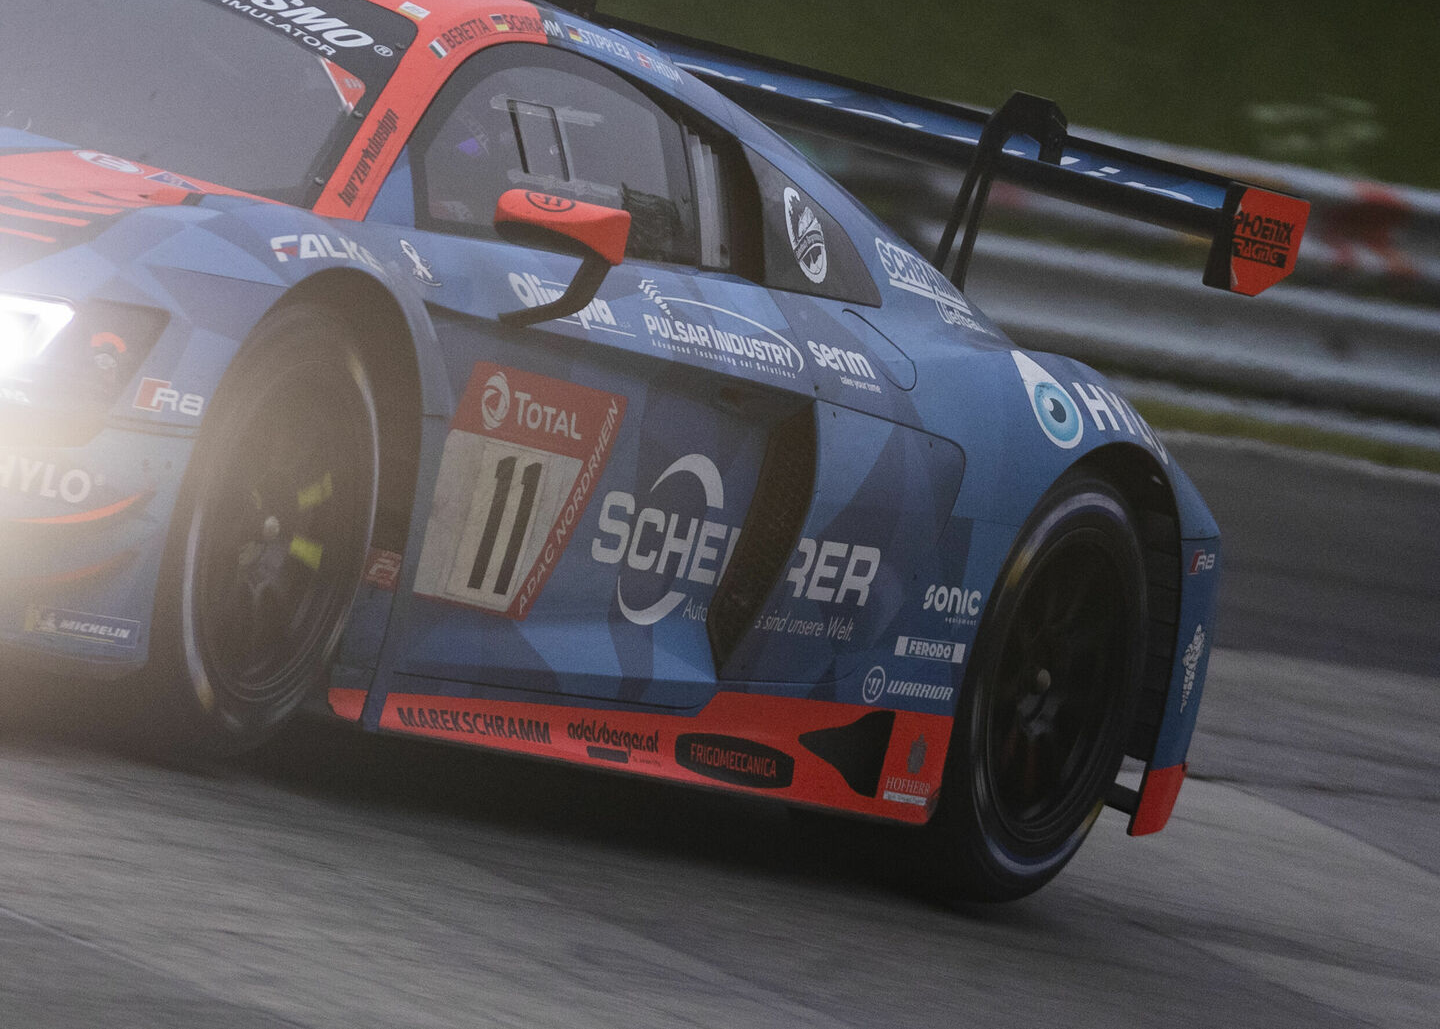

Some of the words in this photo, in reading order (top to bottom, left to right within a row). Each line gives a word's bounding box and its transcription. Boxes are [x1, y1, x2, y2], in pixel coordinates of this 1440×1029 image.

[441, 18, 491, 49] BERETTA
[643, 313, 711, 349] PULSAR
[710, 324, 794, 368] INDUSTRY
[807, 340, 876, 380] serim
[150, 387, 205, 416] R8
[515, 391, 582, 440] TOTAL
[519, 544, 555, 615] ADAC
[557, 398, 619, 544] NORDRHEIN
[467, 456, 543, 595] 11
[1194, 553, 1215, 572] R8
[60, 619, 131, 640] MICHELIN
[789, 619, 824, 636] unsere
[909, 640, 952, 659] FERODO
[887, 680, 954, 701] WARRIOR
[690, 743, 777, 779] FRIGOMECCANICA
